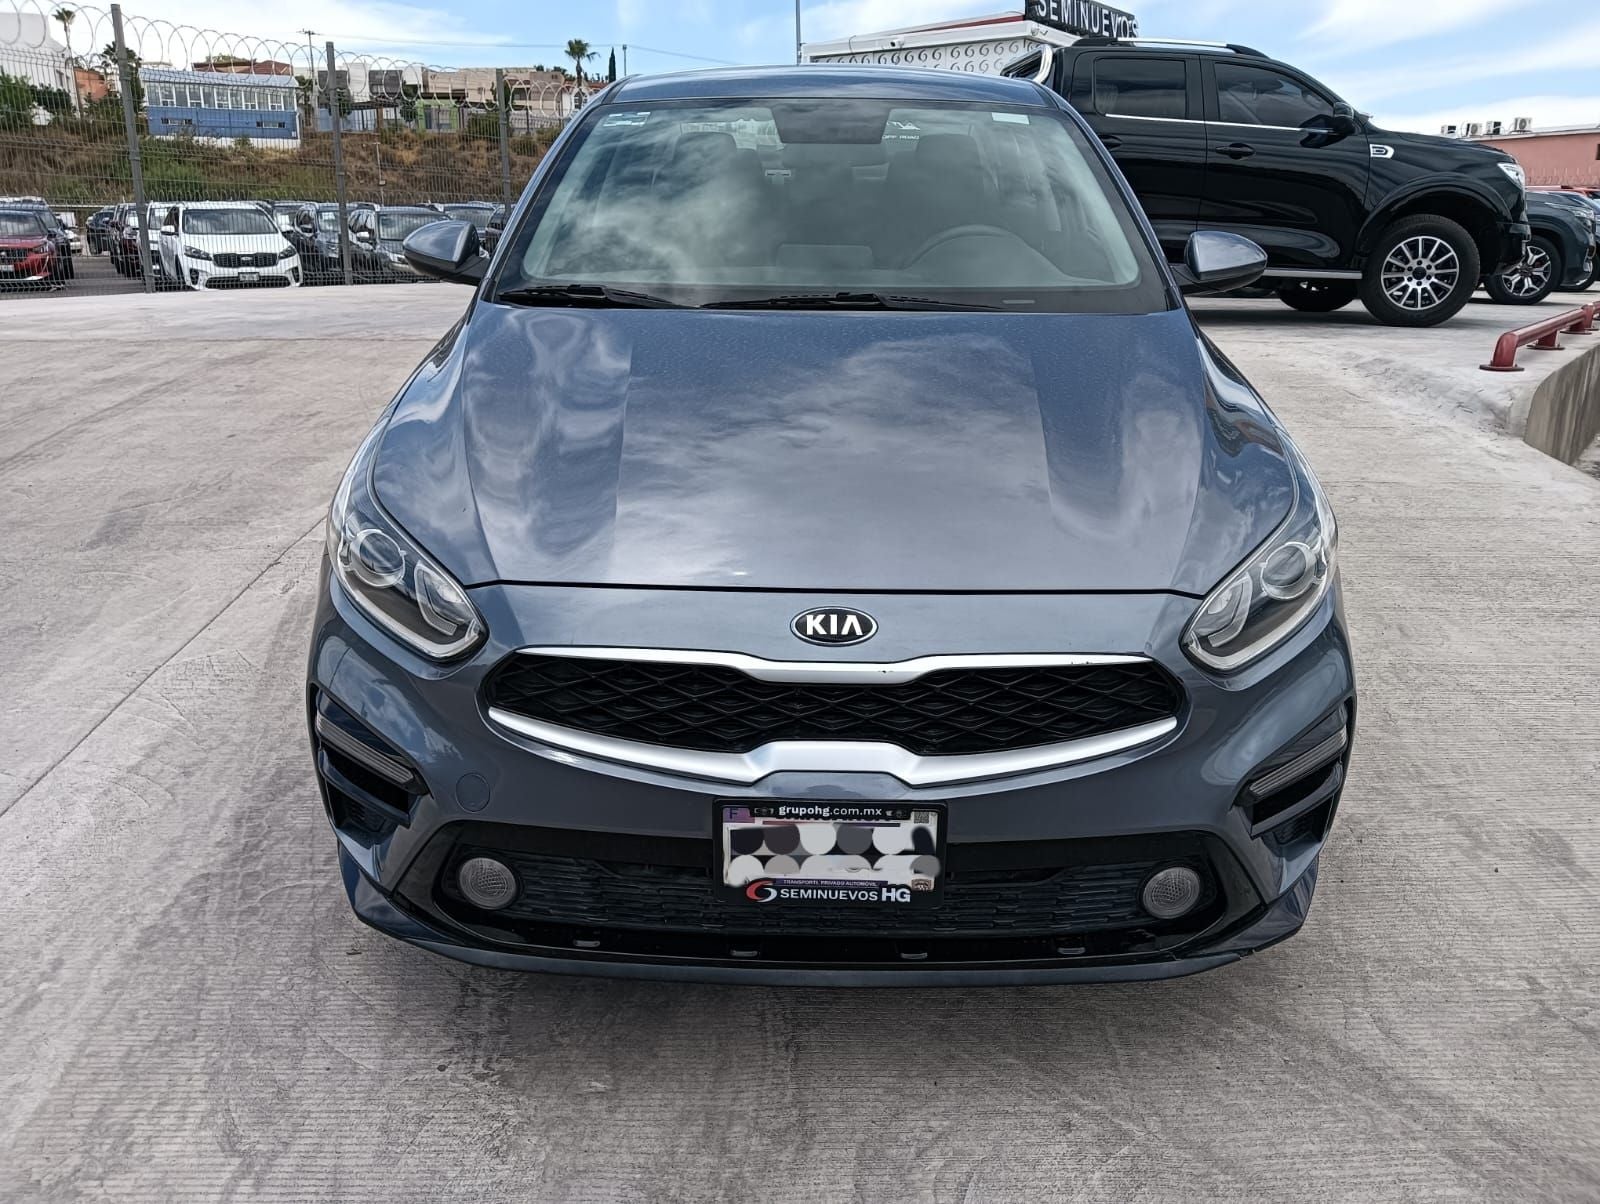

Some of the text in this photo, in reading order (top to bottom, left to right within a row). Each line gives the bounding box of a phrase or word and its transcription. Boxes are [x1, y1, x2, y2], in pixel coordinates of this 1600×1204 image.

[1035, 0, 1139, 38] SEMINUEVOS
[806, 614, 863, 636] KIA
[778, 805, 882, 816] grupohg.com.mx
[780, 887, 911, 903] SEMINUEVOS HG
